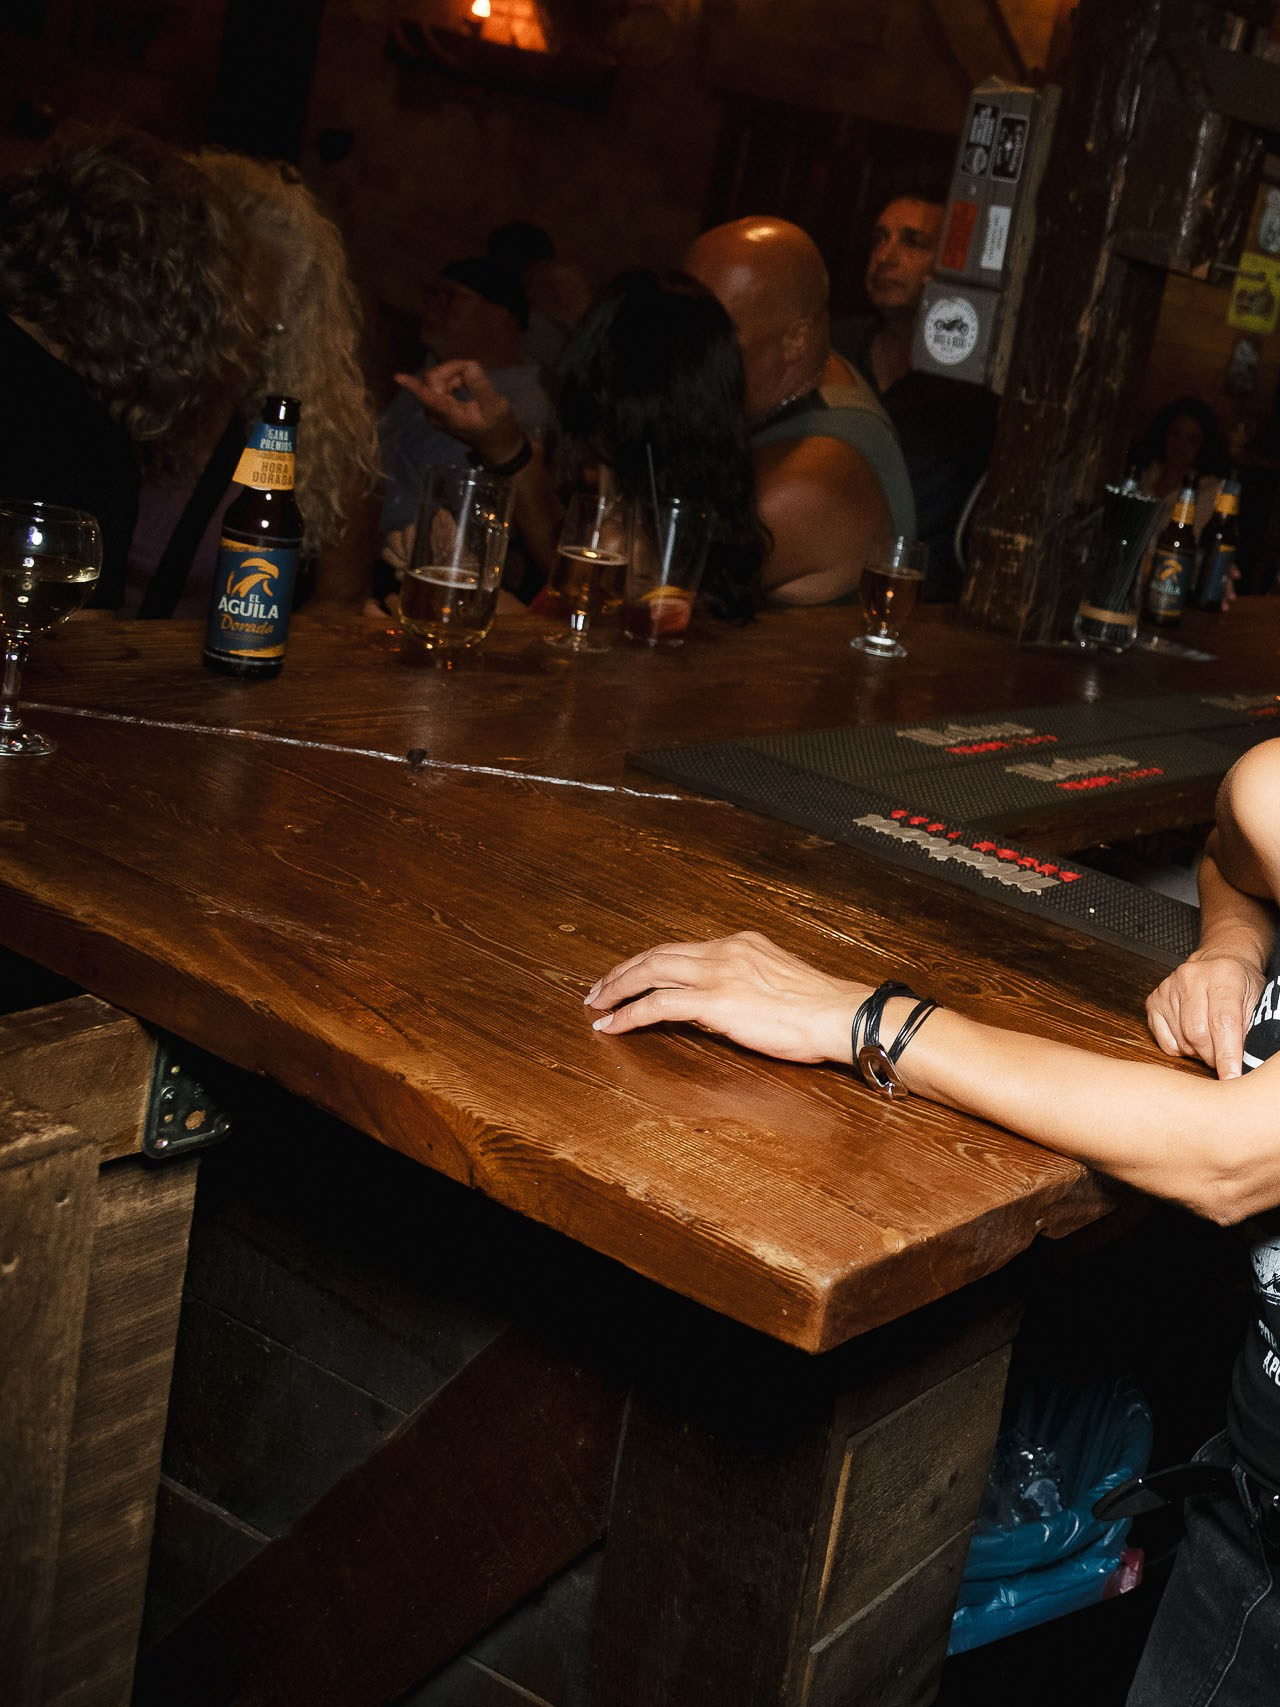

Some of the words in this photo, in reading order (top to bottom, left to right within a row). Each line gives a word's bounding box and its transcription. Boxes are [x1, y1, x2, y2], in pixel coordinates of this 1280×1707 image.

[268, 429, 288, 440] GANA
[260, 438, 293, 452] PREMIOS
[249, 593, 260, 604] EL
[220, 613, 274, 634] Dorada
